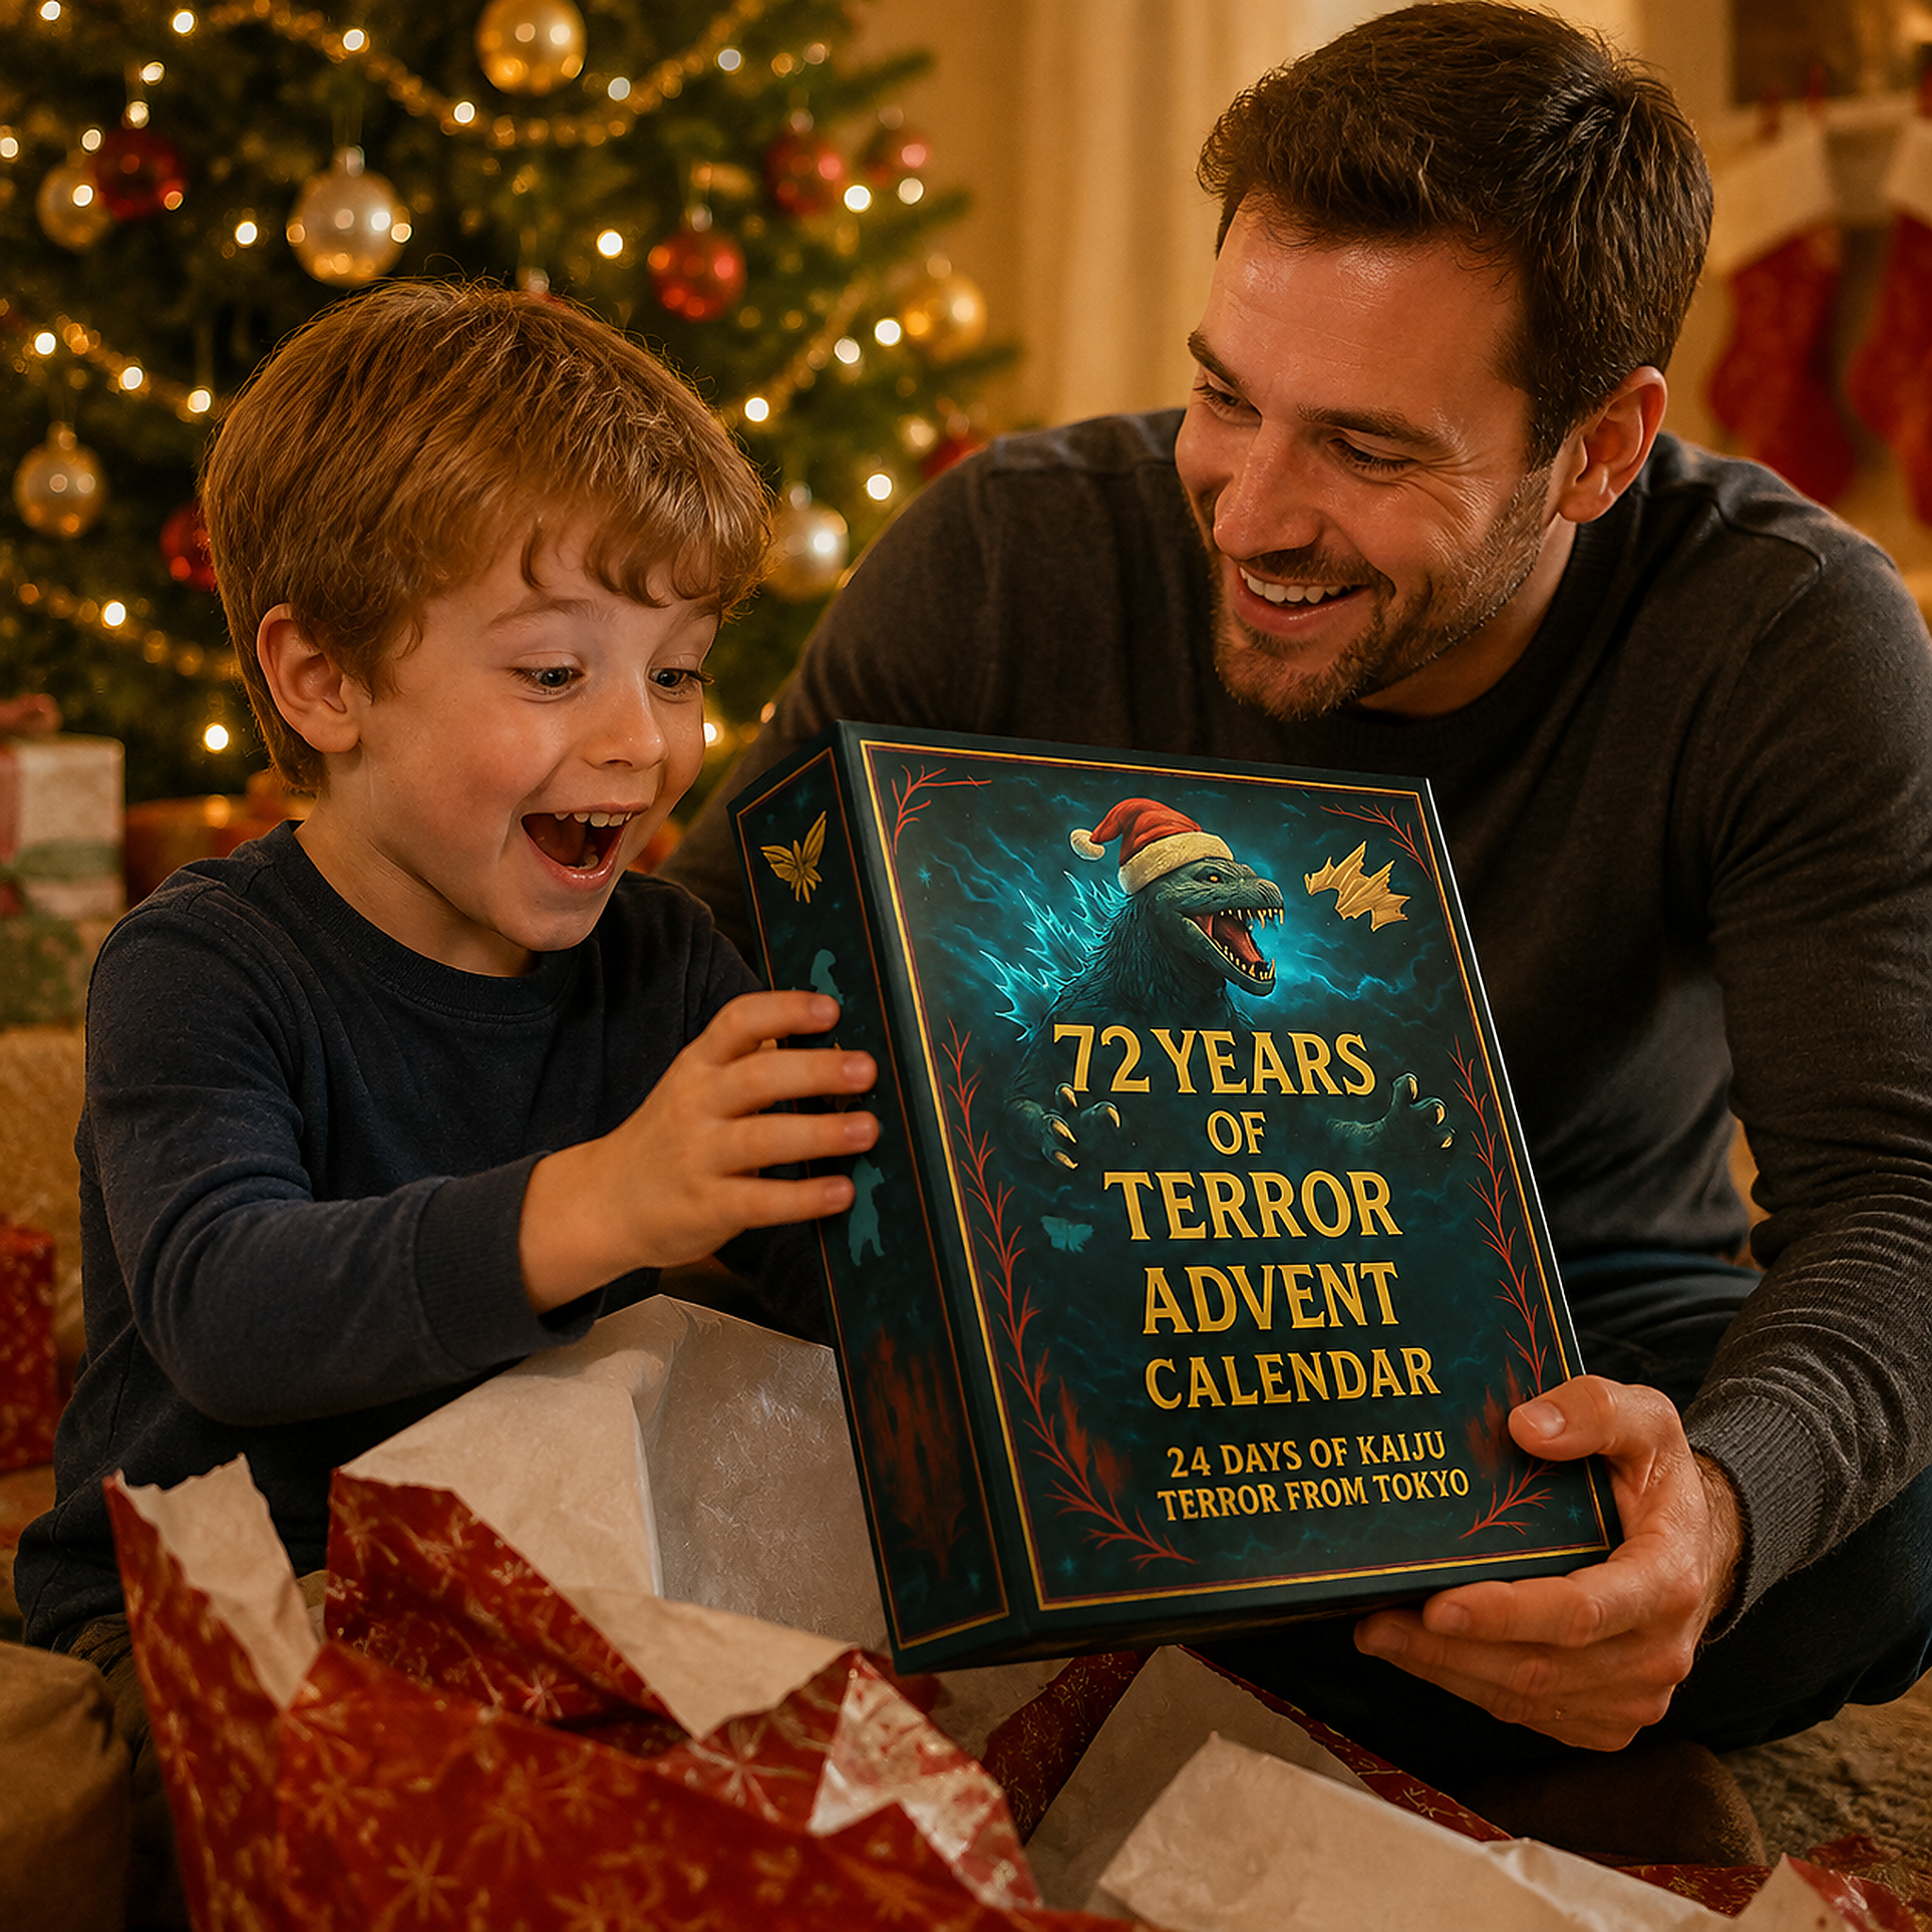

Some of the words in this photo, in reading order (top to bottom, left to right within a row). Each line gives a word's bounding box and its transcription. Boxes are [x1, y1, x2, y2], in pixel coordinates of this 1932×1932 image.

[1053, 1024, 1151, 1093] 72
[1149, 1028, 1376, 1096] YEARS
[1207, 1109, 1266, 1156] OF
[1104, 1171, 1404, 1241] TERROR
[1142, 1261, 1400, 1335] ADVENT
[1145, 1347, 1441, 1410] CALENDAR
[1167, 1446, 1211, 1478] 24
[1219, 1440, 1303, 1475] DAYS
[1309, 1437, 1348, 1469] OF
[1356, 1430, 1446, 1465] KAIJU
[1157, 1483, 1282, 1522] TERROR
[1284, 1475, 1370, 1511] FROM
[1372, 1468, 1470, 1503] TOKYO
